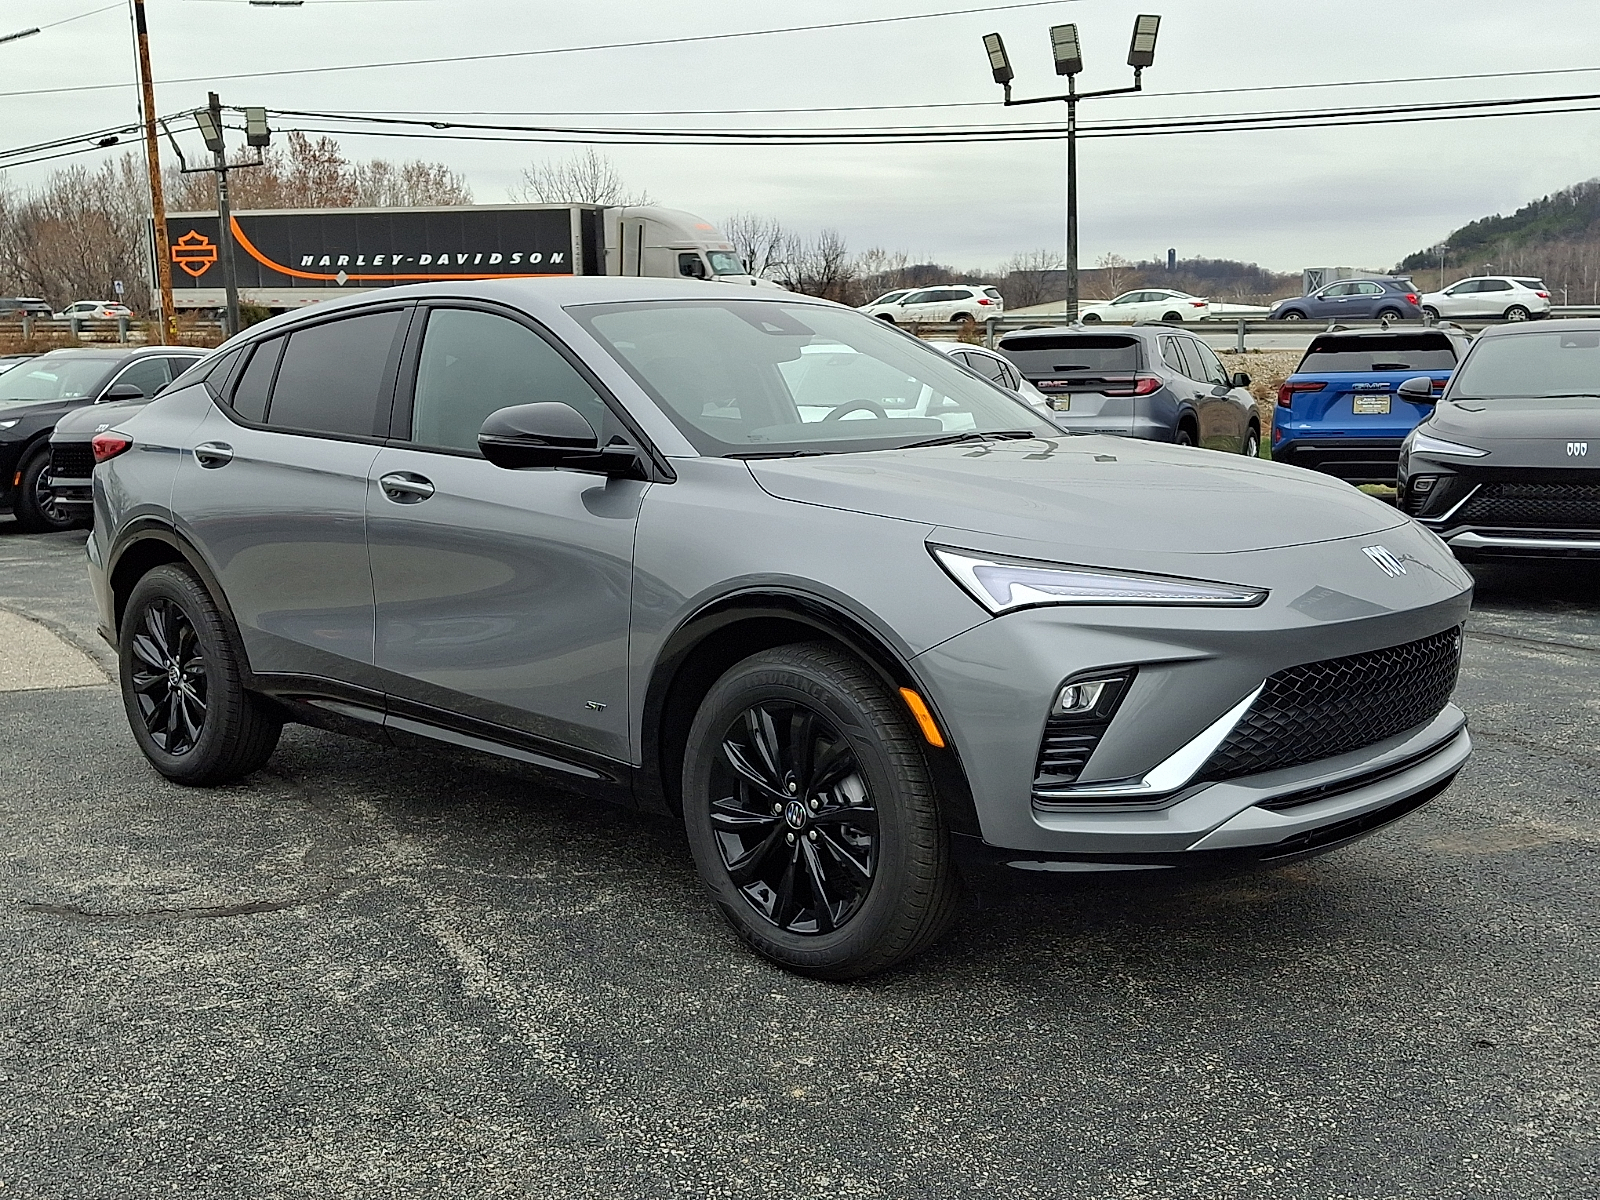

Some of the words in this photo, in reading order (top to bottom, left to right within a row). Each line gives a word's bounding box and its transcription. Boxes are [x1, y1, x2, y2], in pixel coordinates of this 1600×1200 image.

[301, 252, 564, 266] HARLEY-DAVIDSON
[1351, 382, 1391, 390] GMC
[584, 700, 607, 711] ST
